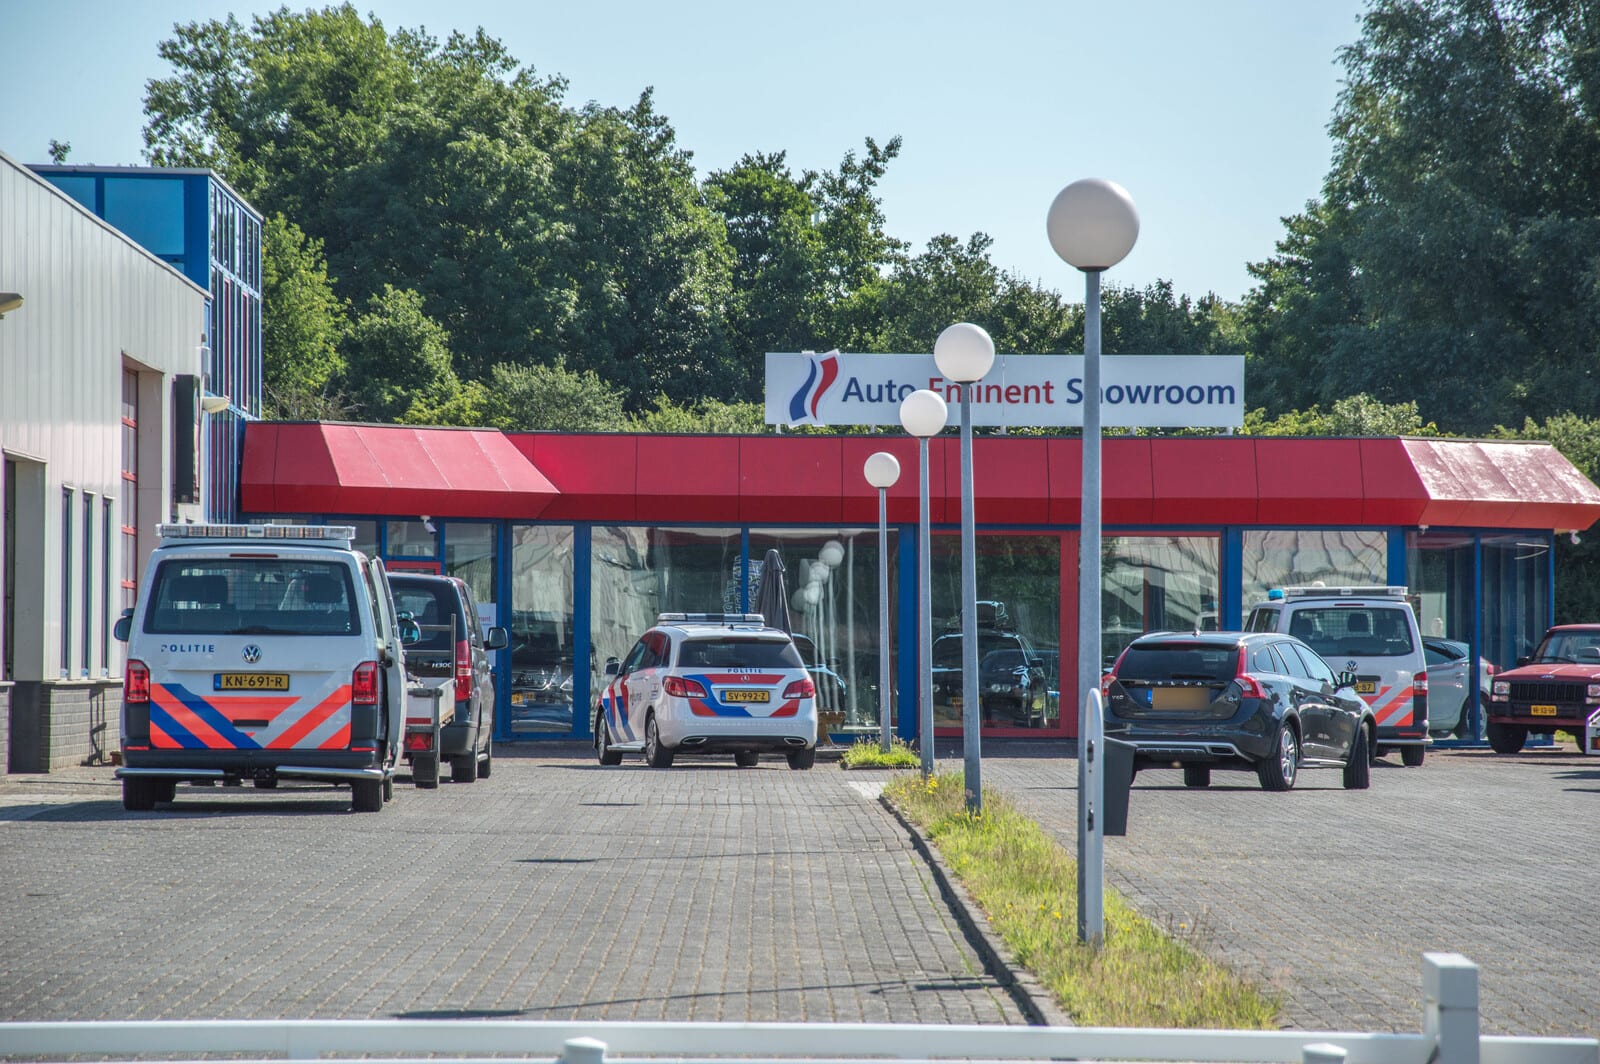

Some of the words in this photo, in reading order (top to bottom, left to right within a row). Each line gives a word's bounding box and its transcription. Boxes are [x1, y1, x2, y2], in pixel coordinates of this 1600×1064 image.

[1066, 377, 1236, 405] Sowroom
[225, 676, 283, 687] KN-691-R
[727, 692, 766, 700] SV-992-Z
